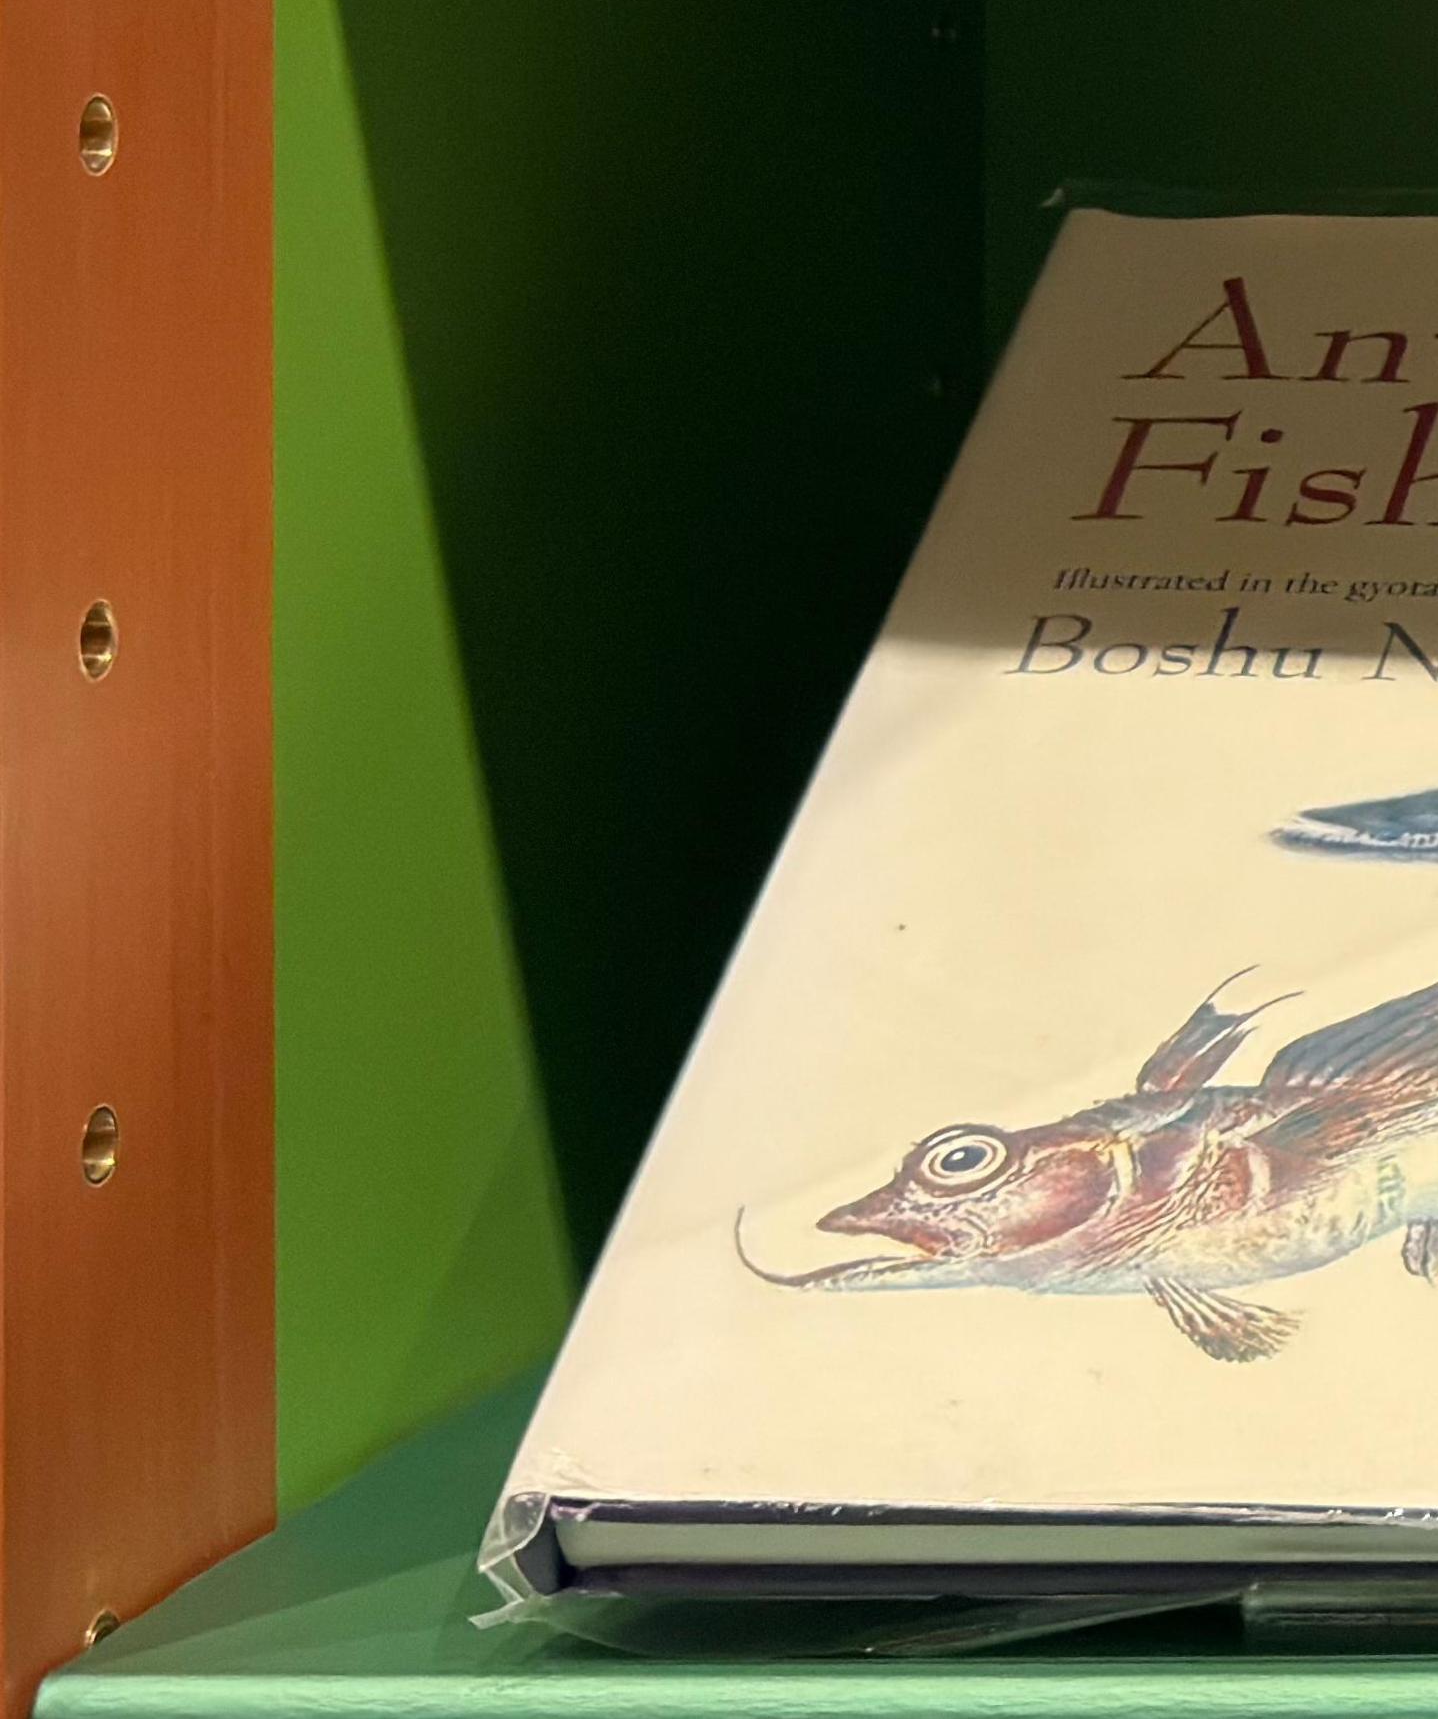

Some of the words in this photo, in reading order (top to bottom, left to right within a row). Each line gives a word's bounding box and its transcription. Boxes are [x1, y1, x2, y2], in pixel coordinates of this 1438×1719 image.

[1054, 569, 1229, 592] Illustrated
[1240, 574, 1273, 594] in
[1285, 574, 1339, 596] the
[1002, 607, 1323, 683] Boshu
